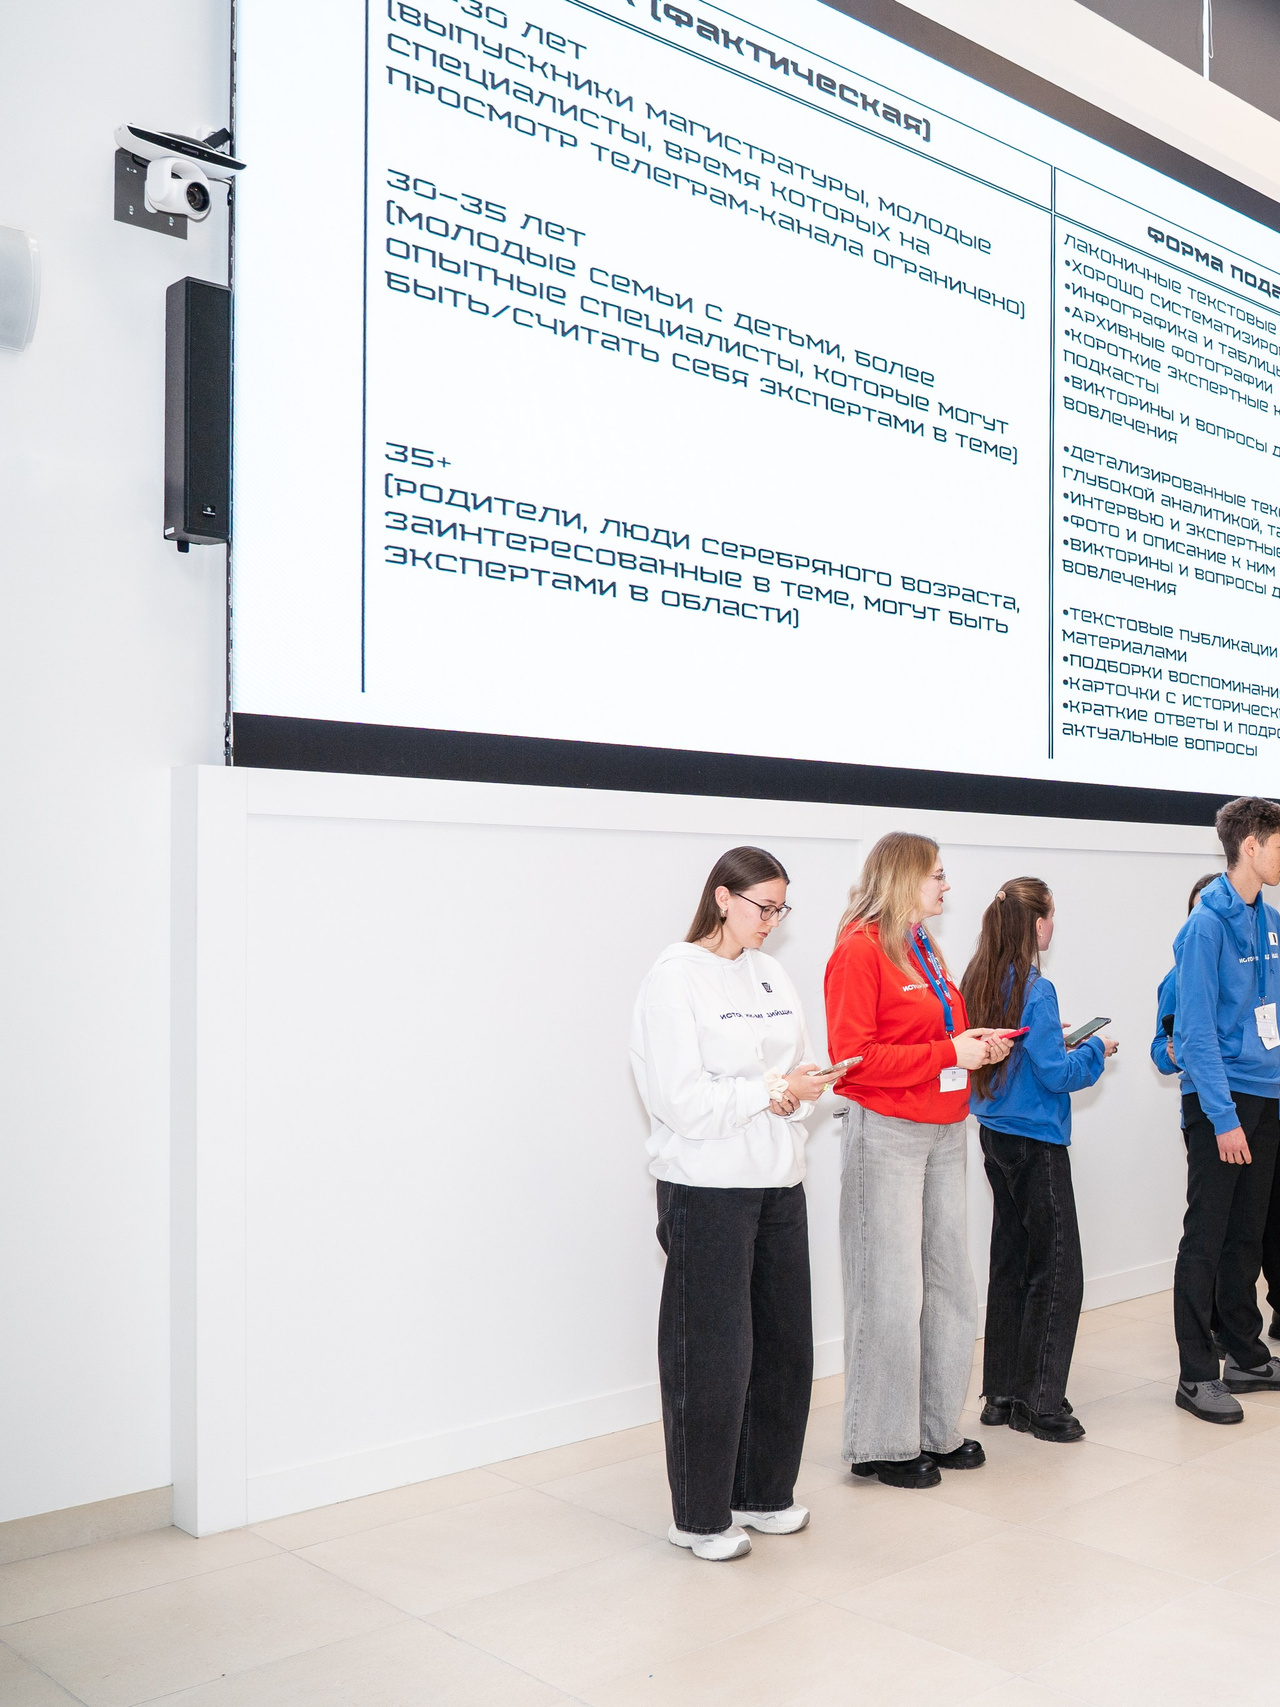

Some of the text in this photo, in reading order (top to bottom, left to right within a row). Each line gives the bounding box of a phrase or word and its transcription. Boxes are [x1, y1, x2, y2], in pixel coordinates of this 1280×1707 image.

[453, 0, 587, 59] 30 лет
[388, 33, 929, 255] специалисты, время которых на
[386, 66, 1024, 319] просмотр телеграм-канала ограничено)
[646, 103, 868, 208] магистратуры,
[878, 197, 991, 254] молодые
[520, 214, 586, 246] лет
[1148, 226, 1223, 273] форма
[387, 200, 934, 387] (молодые семьи с детьми, более
[1064, 234, 1181, 294] лаконичные
[1187, 287, 1276, 335] текстовые
[386, 238, 1008, 434] опытные специалисты, которые могут
[1204, 336, 1212, 350] и
[385, 271, 1017, 465] быть/считать себя экспертами в теме)
[1064, 349, 1158, 394] подкасты
[1168, 366, 1268, 412] экспертные
[1172, 345, 1272, 394] фотографии
[1063, 396, 1178, 444] вовлечения
[1180, 413, 1189, 426] и
[1196, 418, 1267, 452] вопросы
[385, 442, 451, 468] 35+
[1062, 466, 1154, 502] глубокой
[1161, 494, 1262, 534] аналитикой,
[385, 473, 1019, 613] (родители, люди серебряного возраста,
[1170, 518, 1179, 531] и
[385, 511, 1008, 633] заинтересованные в теме, могут быть
[1126, 529, 1136, 542] и
[1143, 534, 1226, 564] описание
[1232, 556, 1241, 568] к
[1247, 560, 1275, 576] ним
[385, 545, 798, 628] экспертами в области)
[1062, 559, 1177, 595] вовлечения
[1179, 564, 1188, 576] и
[1194, 568, 1266, 594] вопросы
[1062, 629, 1186, 662] материалами
[1179, 629, 1277, 658] публикации
[1166, 692, 1176, 704] с
[1063, 723, 1257, 756] актуальные вопросы
[1155, 712, 1218, 731] ответы
[1224, 721, 1232, 732] и
